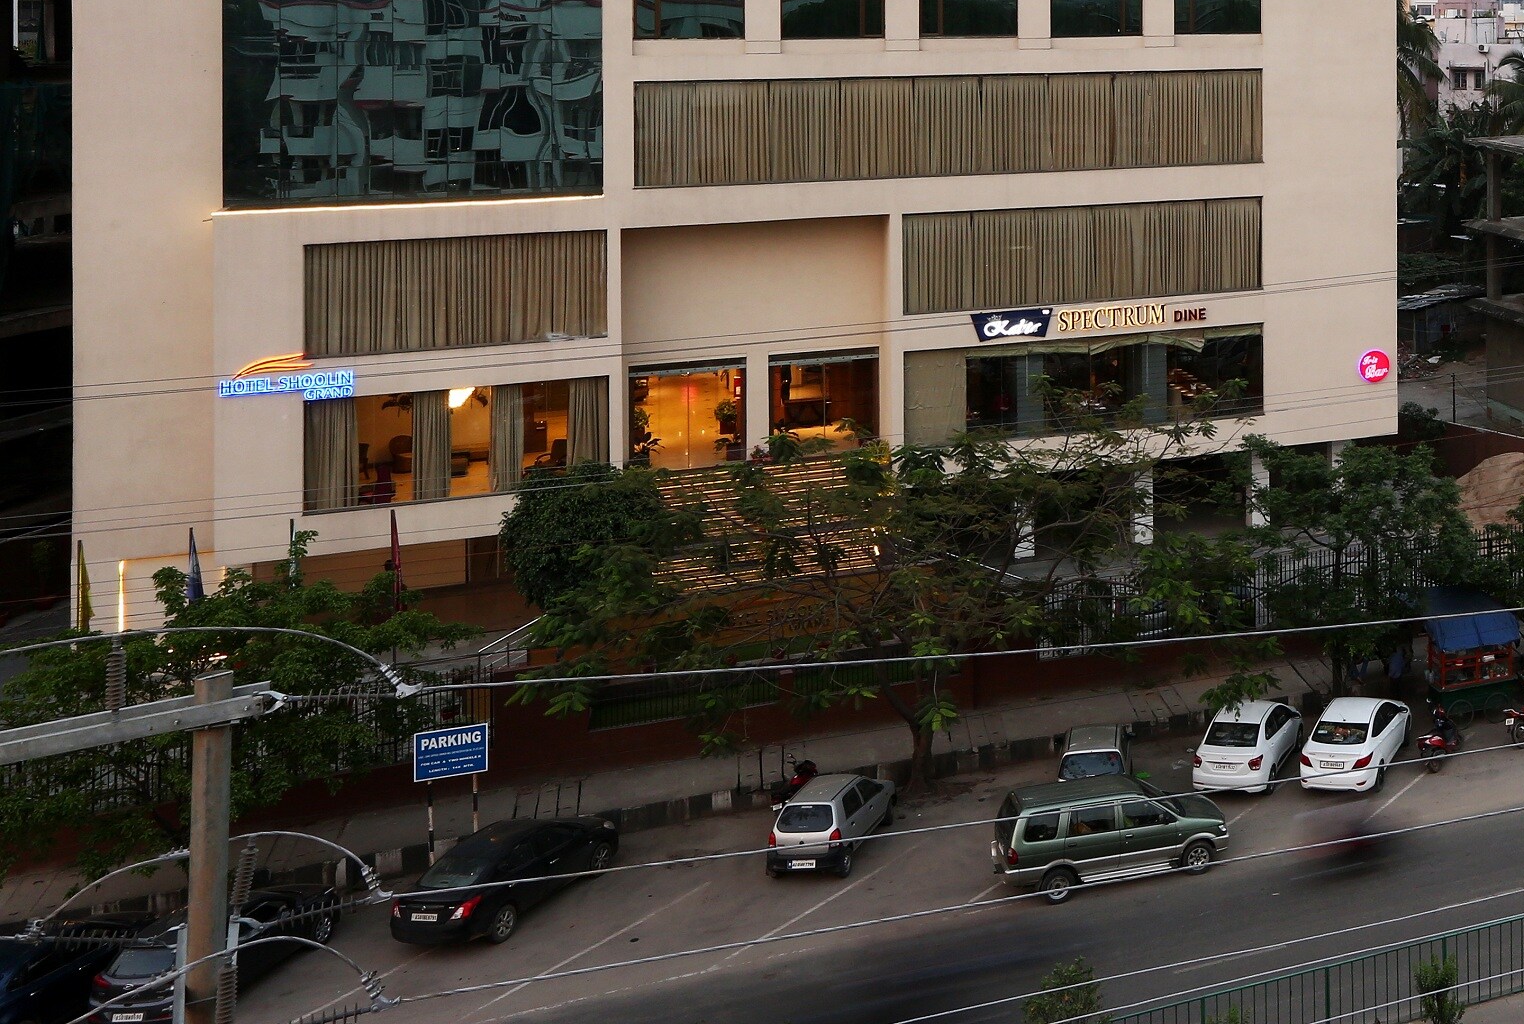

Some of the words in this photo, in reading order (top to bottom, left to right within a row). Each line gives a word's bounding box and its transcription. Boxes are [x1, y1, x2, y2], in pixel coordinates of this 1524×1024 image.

[1058, 303, 1167, 332] SPECTRUM
[1173, 308, 1207, 322] DINE
[1365, 364, 1388, 378] Bar
[219, 377, 274, 395] HOTEL
[277, 370, 354, 390] SHOOLIN
[303, 386, 353, 400] GRAND
[421, 730, 482, 751] PARKING
